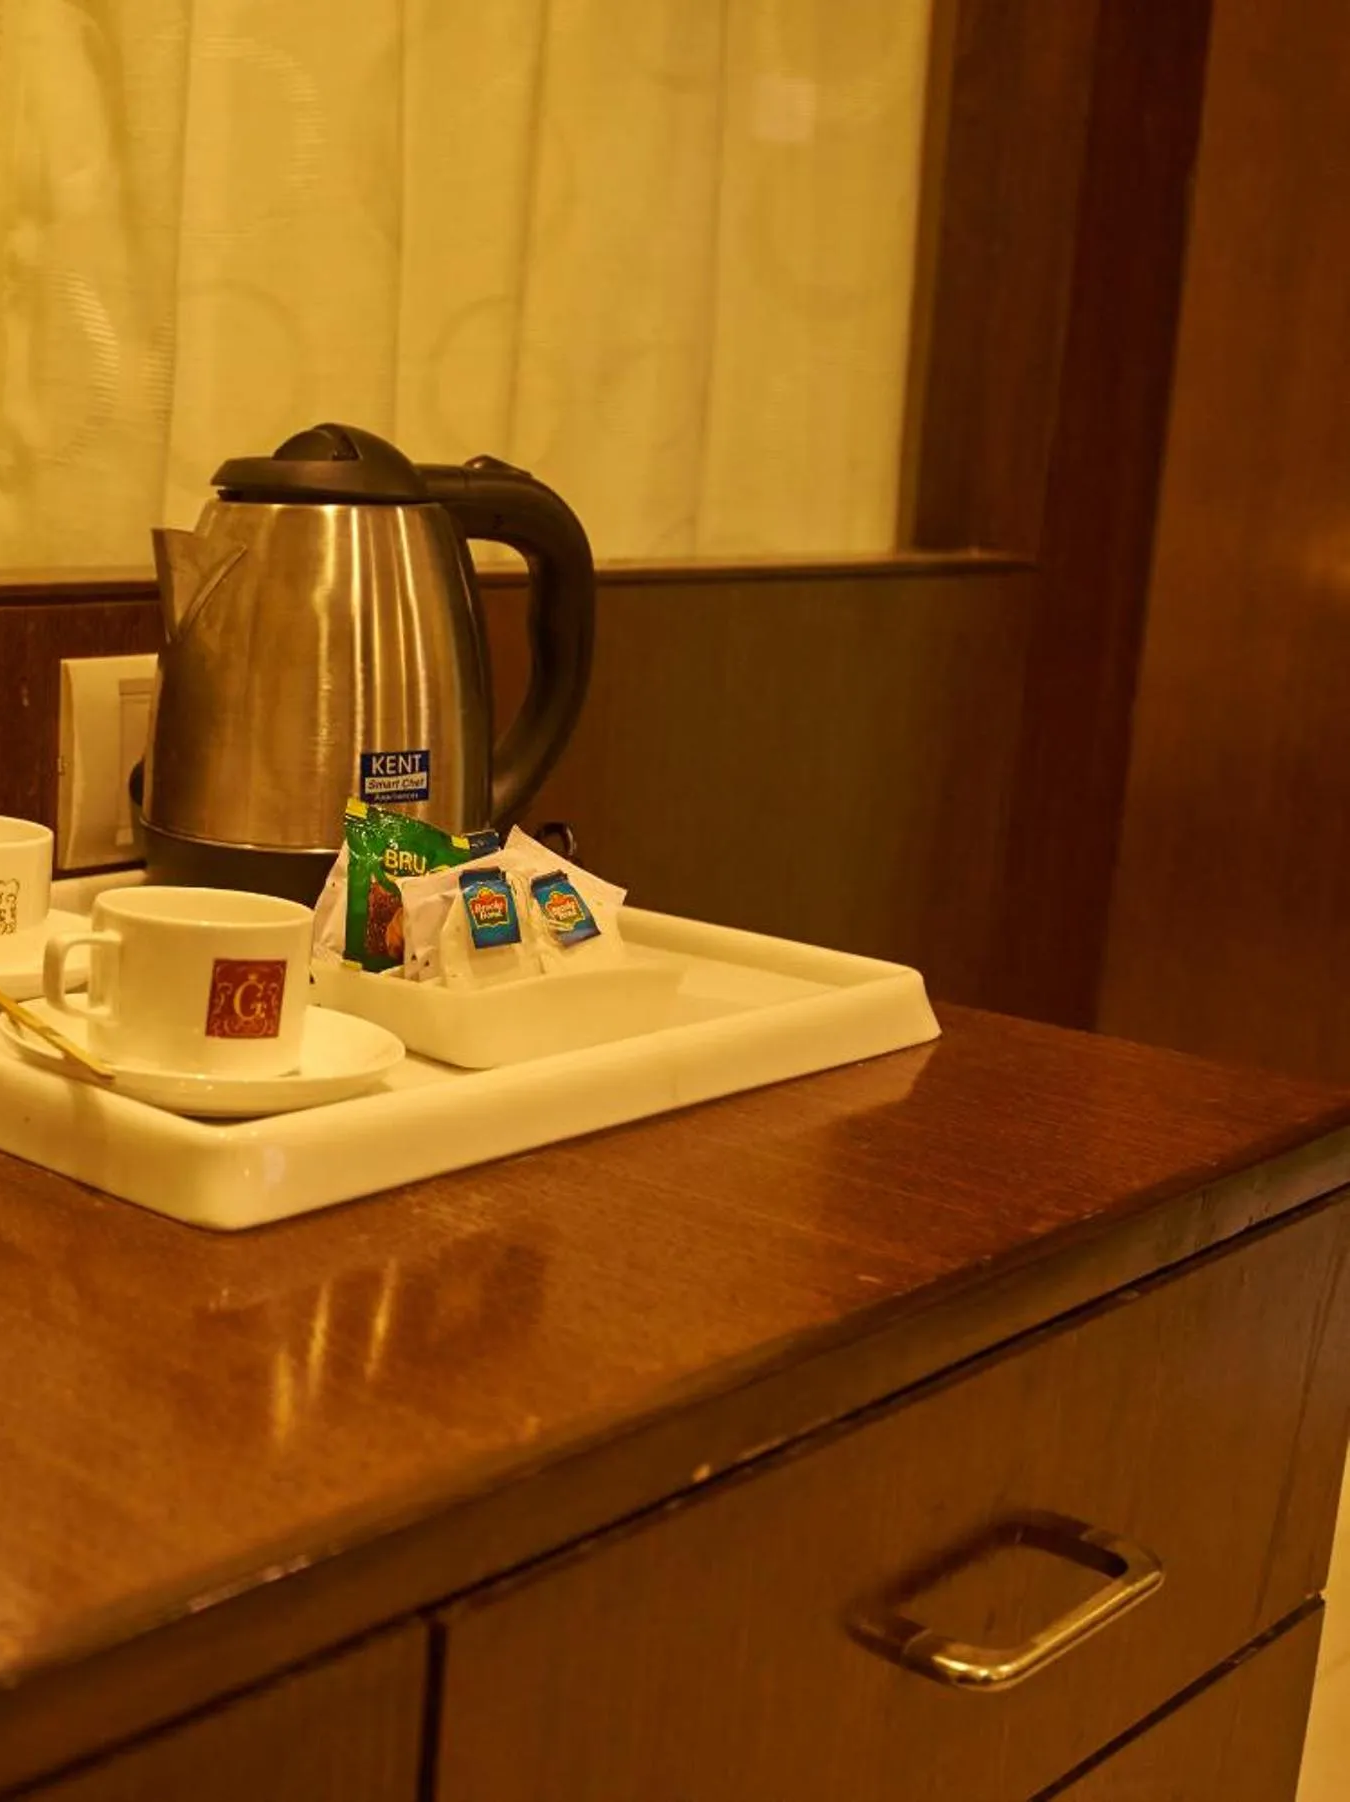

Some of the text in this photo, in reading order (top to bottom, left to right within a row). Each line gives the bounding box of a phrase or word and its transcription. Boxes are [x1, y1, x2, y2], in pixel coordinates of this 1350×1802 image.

[372, 754, 422, 775] KENT
[368, 778, 400, 790] Smart
[384, 849, 427, 875] BRU
